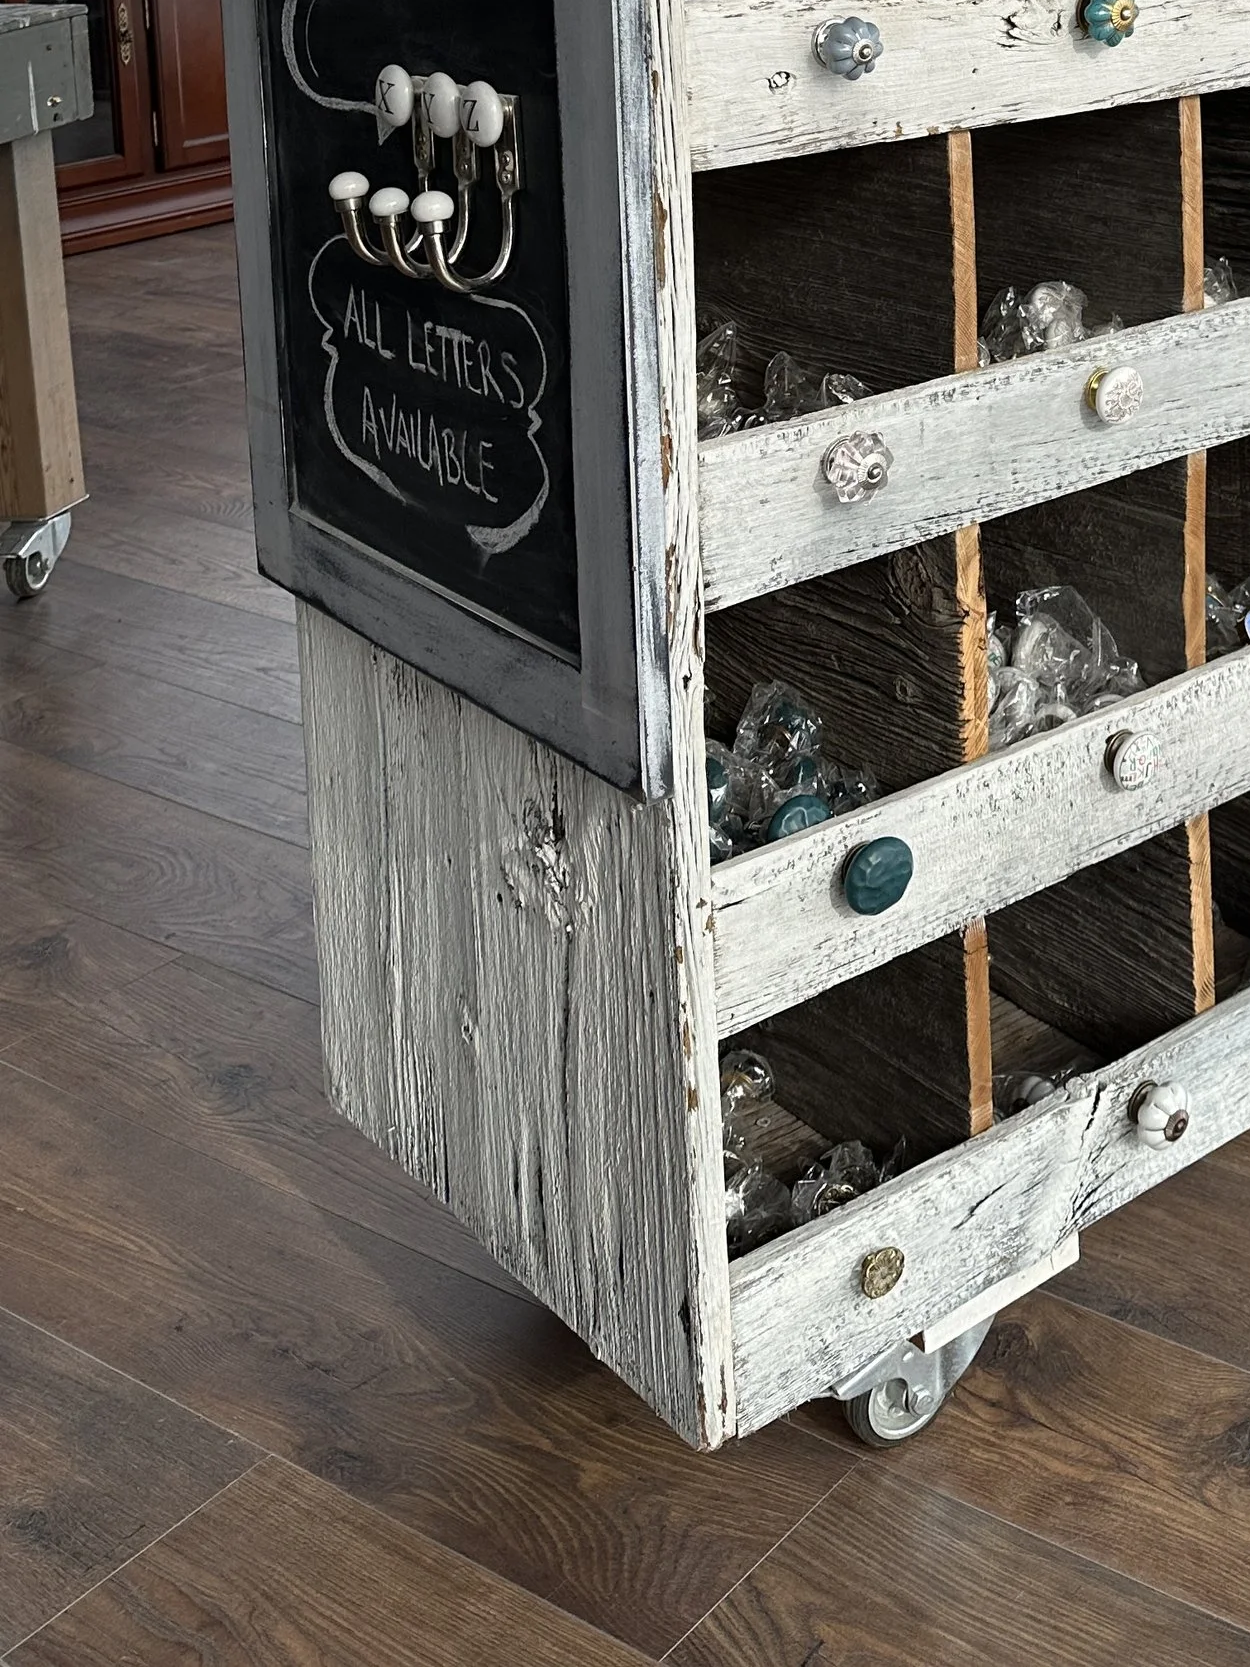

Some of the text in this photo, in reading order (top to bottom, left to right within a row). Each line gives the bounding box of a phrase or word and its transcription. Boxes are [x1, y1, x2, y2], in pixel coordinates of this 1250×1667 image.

[379, 79, 480, 132] X Y Z
[344, 284, 525, 409] ALL LETTERS
[361, 385, 498, 504] AVAILABLE
